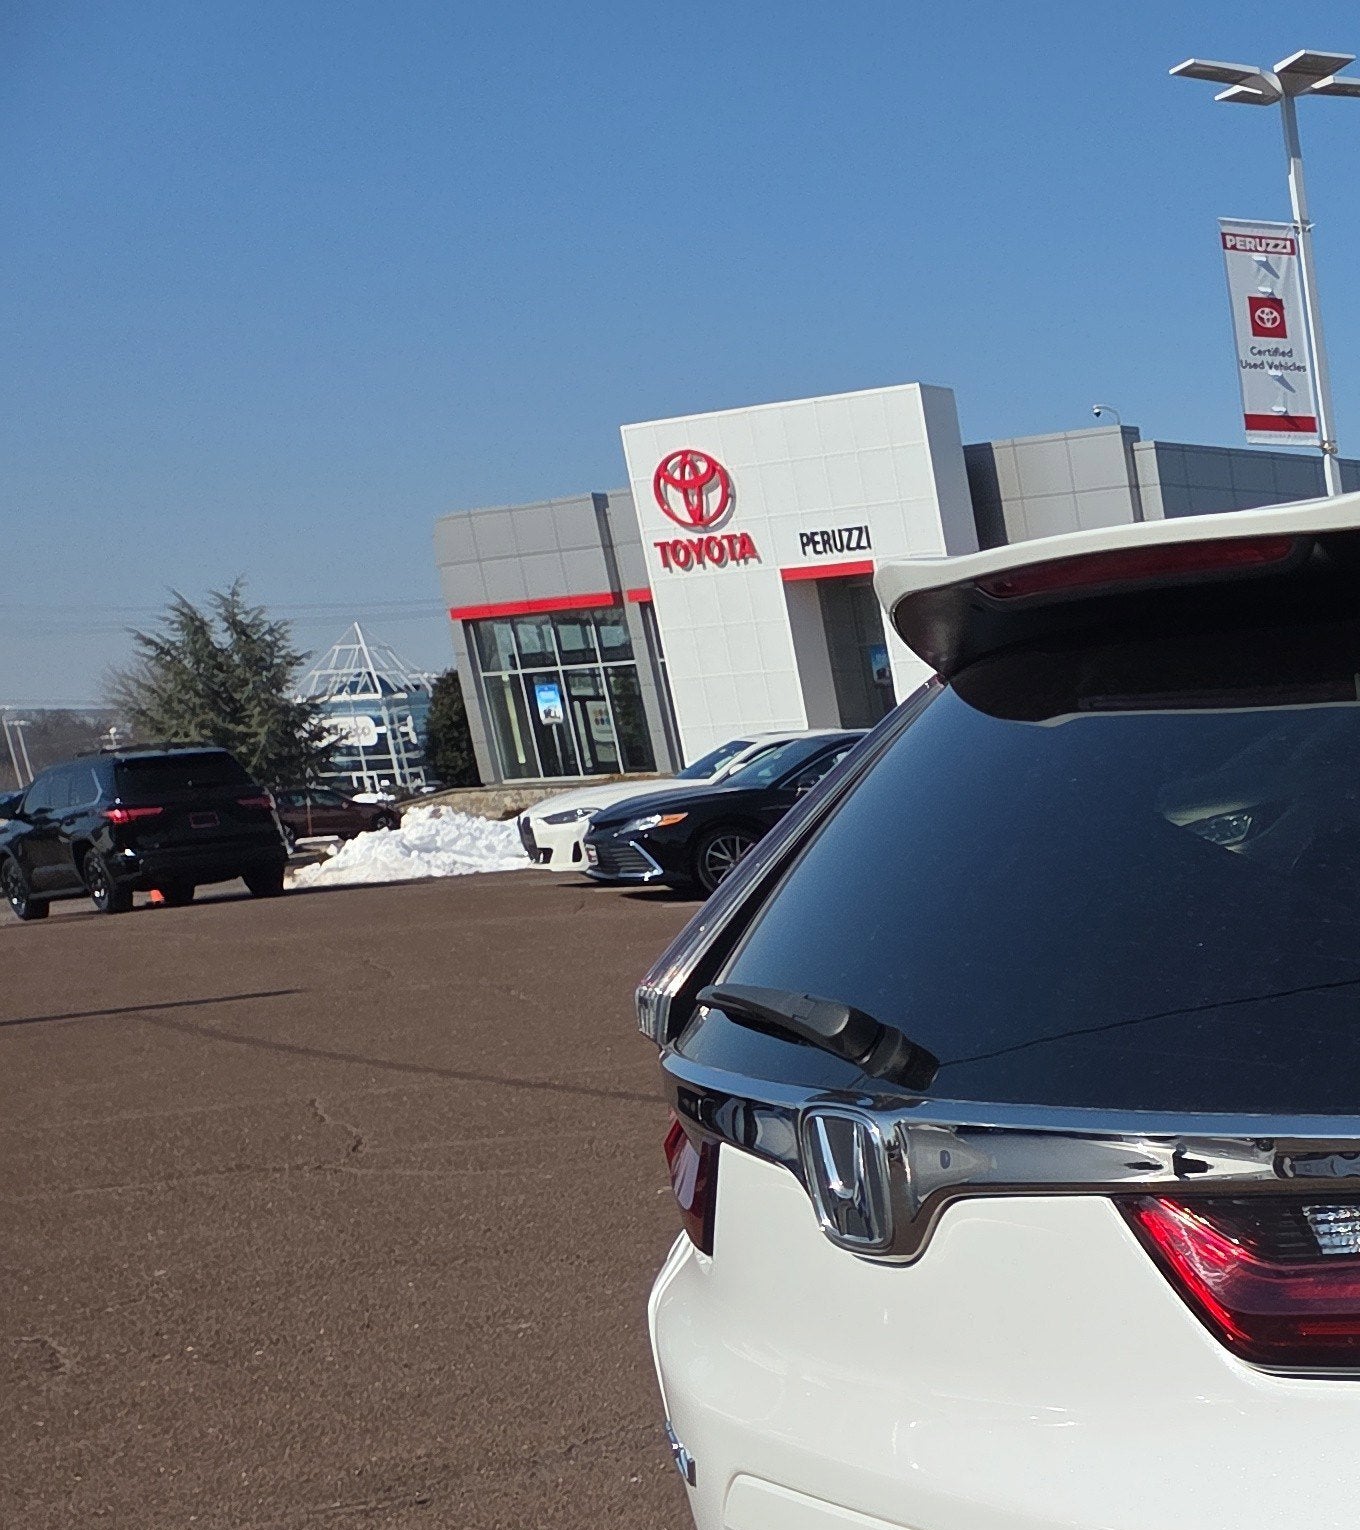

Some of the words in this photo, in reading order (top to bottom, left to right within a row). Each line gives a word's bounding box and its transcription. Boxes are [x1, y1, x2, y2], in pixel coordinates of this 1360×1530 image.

[1225, 234, 1292, 253] PERUZZI
[1249, 345, 1294, 358] Certified
[1240, 359, 1266, 370] Used
[1266, 360, 1307, 373] Vehicles
[798, 525, 873, 557] PERUZZI
[653, 532, 762, 570] TOYOTA
